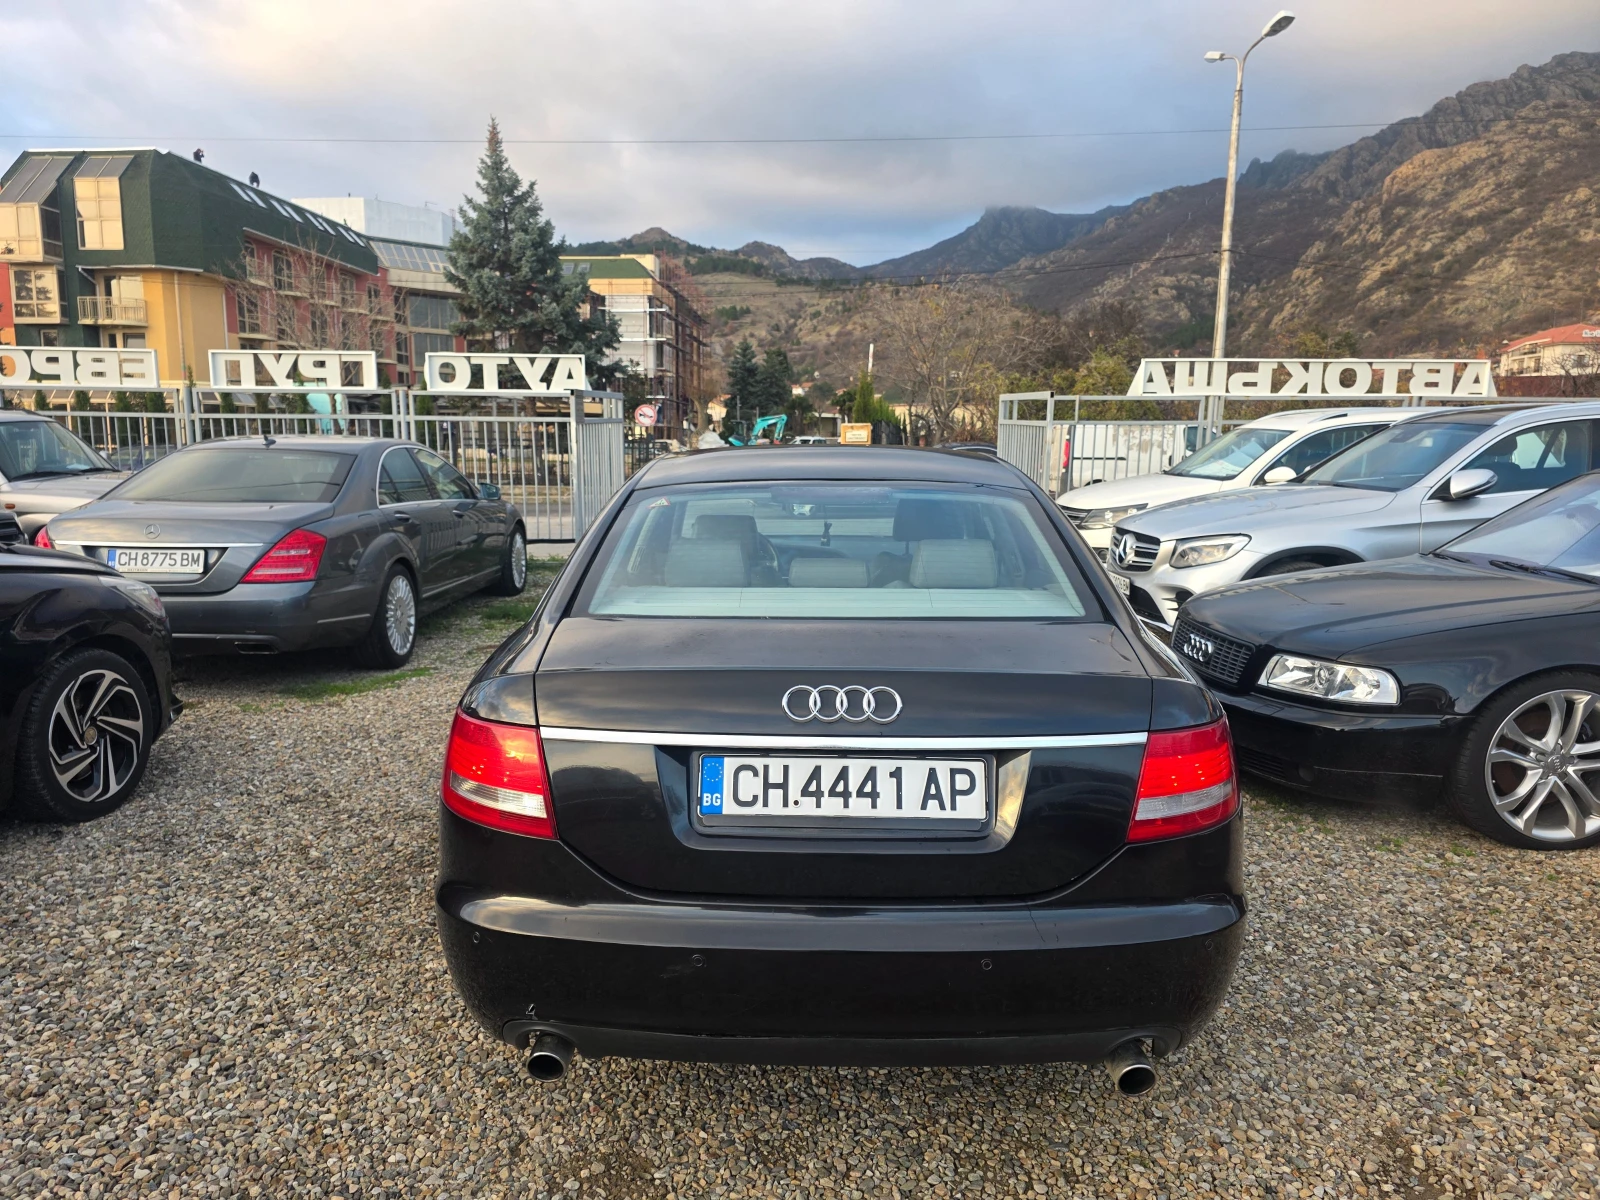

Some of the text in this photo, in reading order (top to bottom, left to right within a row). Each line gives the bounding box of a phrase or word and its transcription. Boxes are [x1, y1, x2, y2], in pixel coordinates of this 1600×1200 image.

[118, 552, 201, 568] CH 8775 BM
[732, 764, 977, 812] CH 4441 AP
[702, 793, 721, 807] BG
